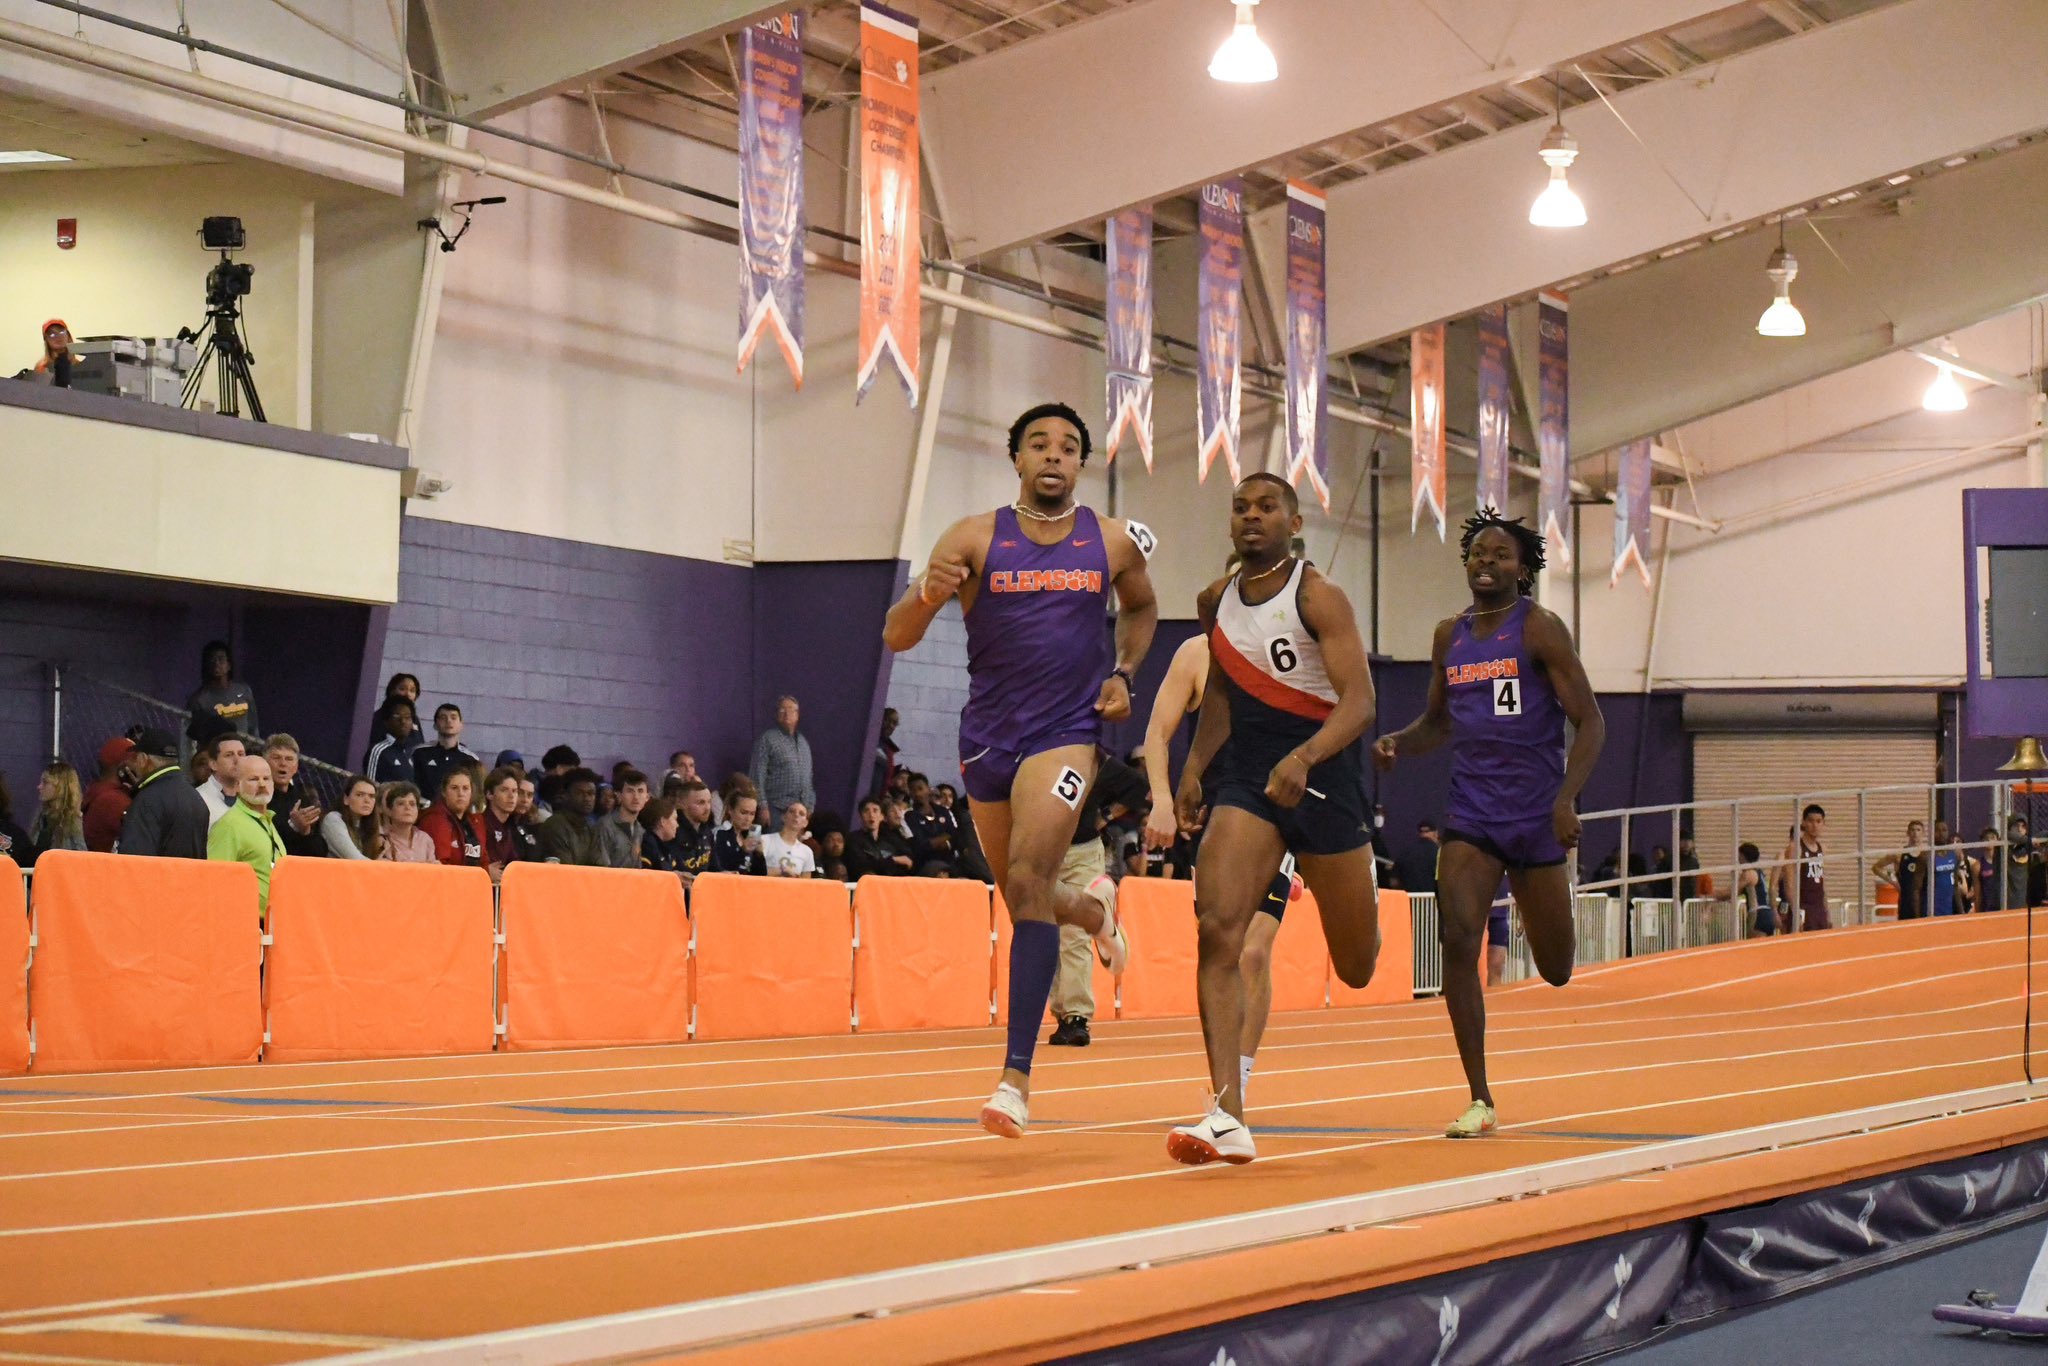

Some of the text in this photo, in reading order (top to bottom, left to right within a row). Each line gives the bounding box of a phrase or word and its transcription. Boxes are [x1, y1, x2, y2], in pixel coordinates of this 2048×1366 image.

[1129, 522, 1153, 553] 5
[989, 568, 1102, 593] CLEMSON
[1270, 638, 1297, 673] 6
[1446, 657, 1519, 686] CLEMSON
[1497, 681, 1517, 713] 4
[1057, 769, 1083, 801] 5
